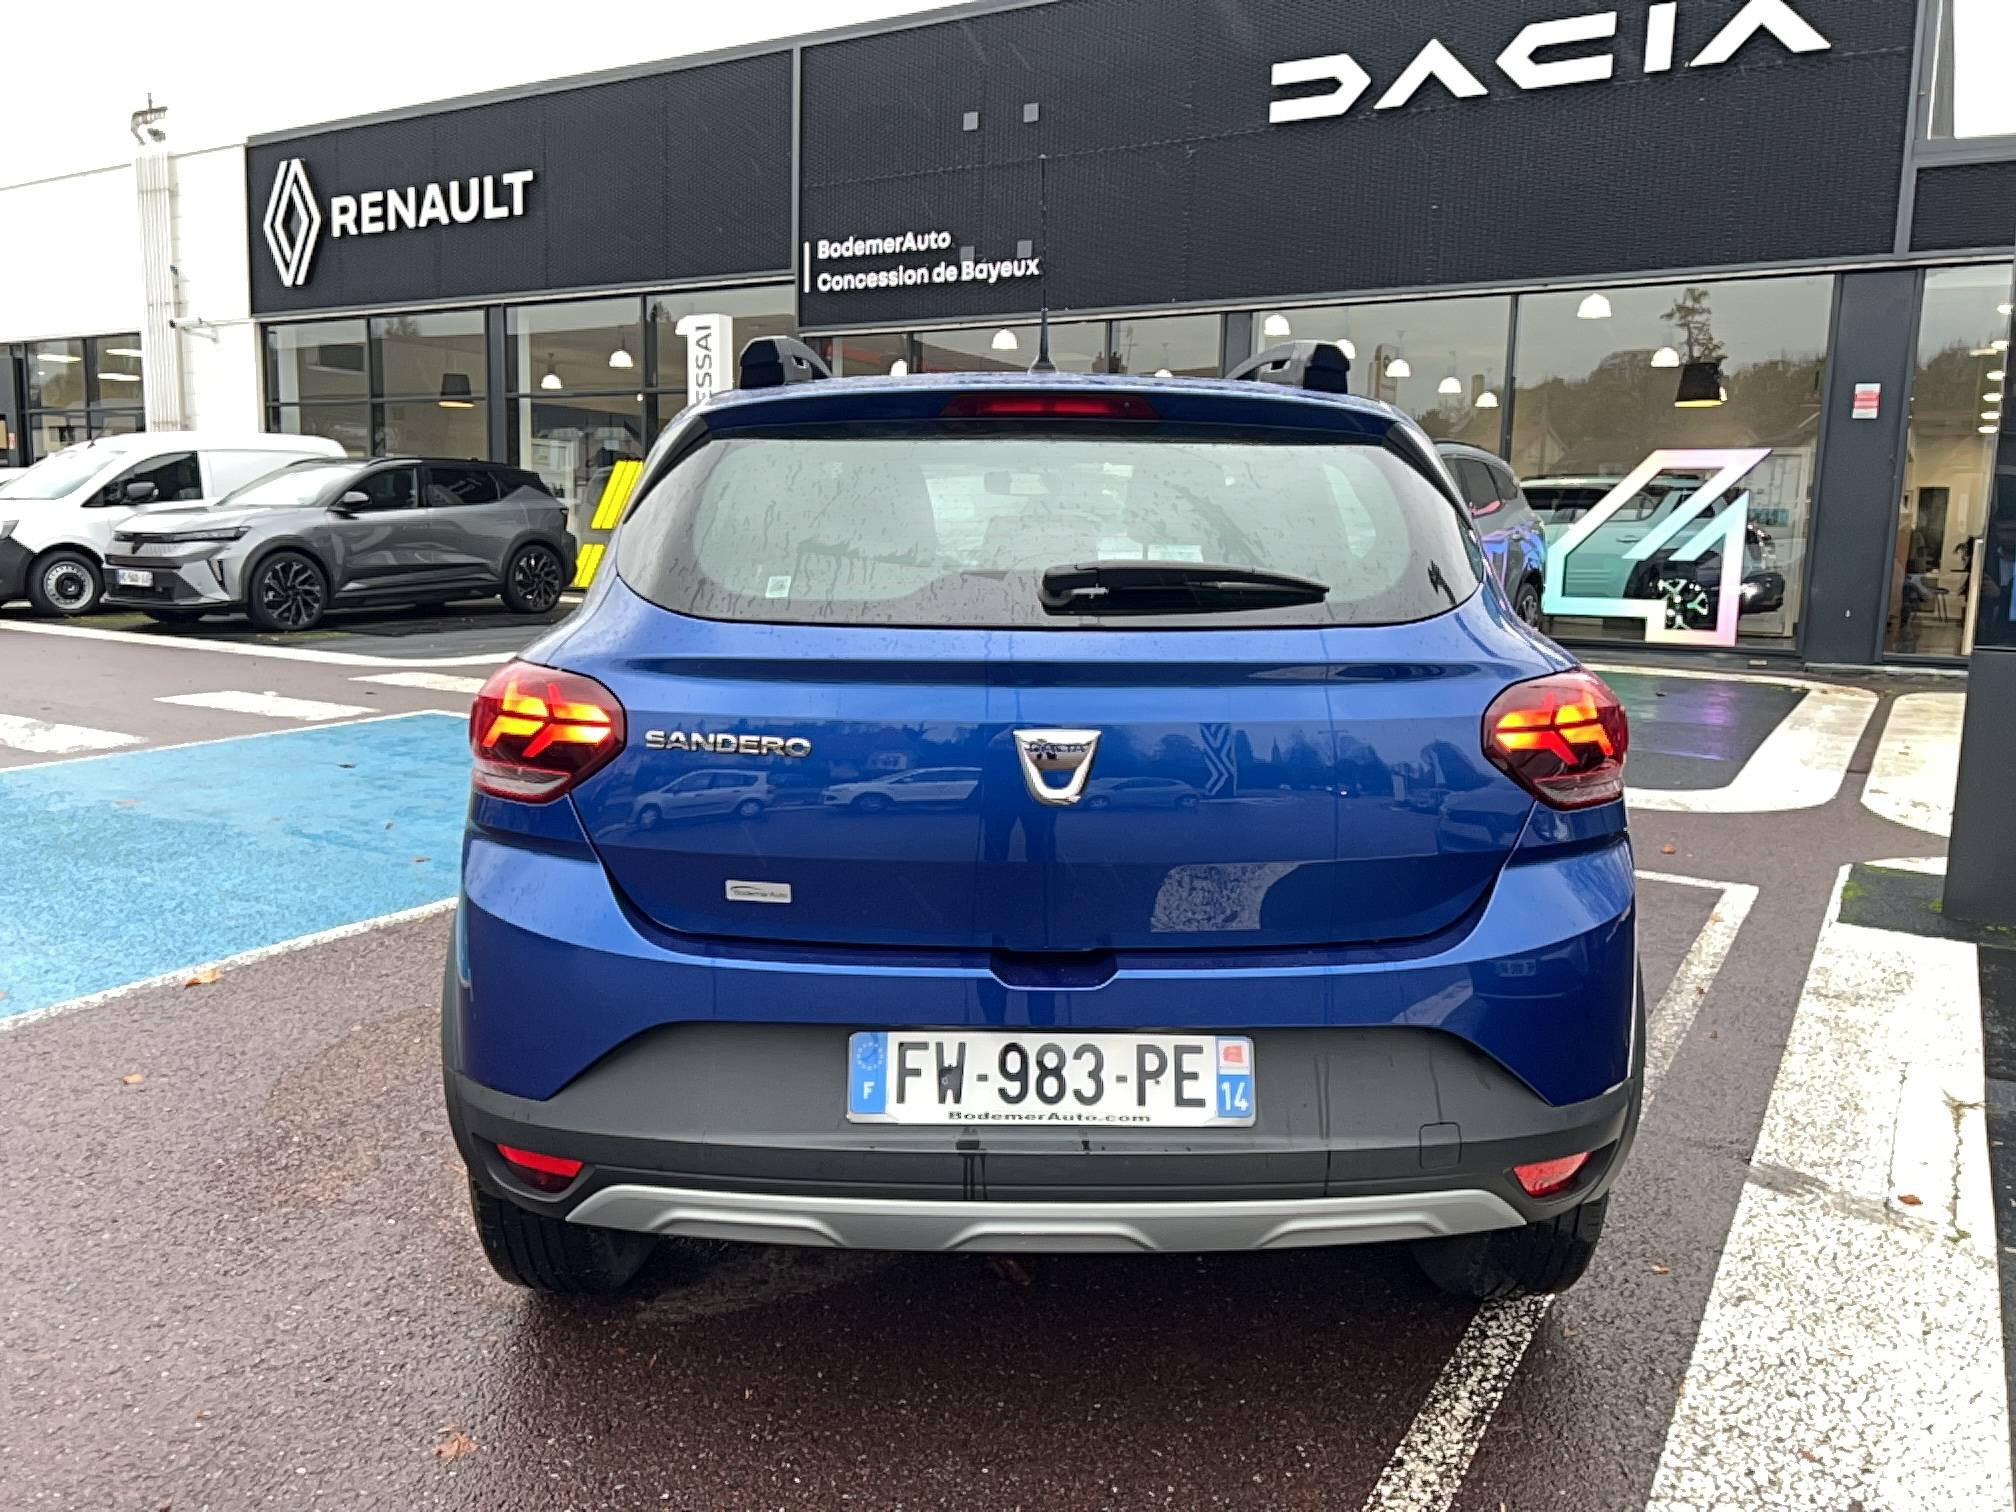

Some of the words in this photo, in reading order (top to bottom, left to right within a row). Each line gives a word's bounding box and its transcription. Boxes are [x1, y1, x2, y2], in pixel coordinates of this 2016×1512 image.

[1269, 0, 1832, 124] DACIA
[330, 168, 535, 239] RENAULT
[817, 230, 952, 260] BodemerAuto
[816, 264, 930, 292] Concession
[932, 261, 958, 283] de
[960, 257, 1040, 284] Bayeux
[645, 730, 812, 758] SANDERO
[896, 1041, 1206, 1107] FW-983-PE
[863, 1081, 875, 1099] F
[1221, 1082, 1248, 1111] 14
[948, 1111, 1151, 1122] BodemerAuto.com
